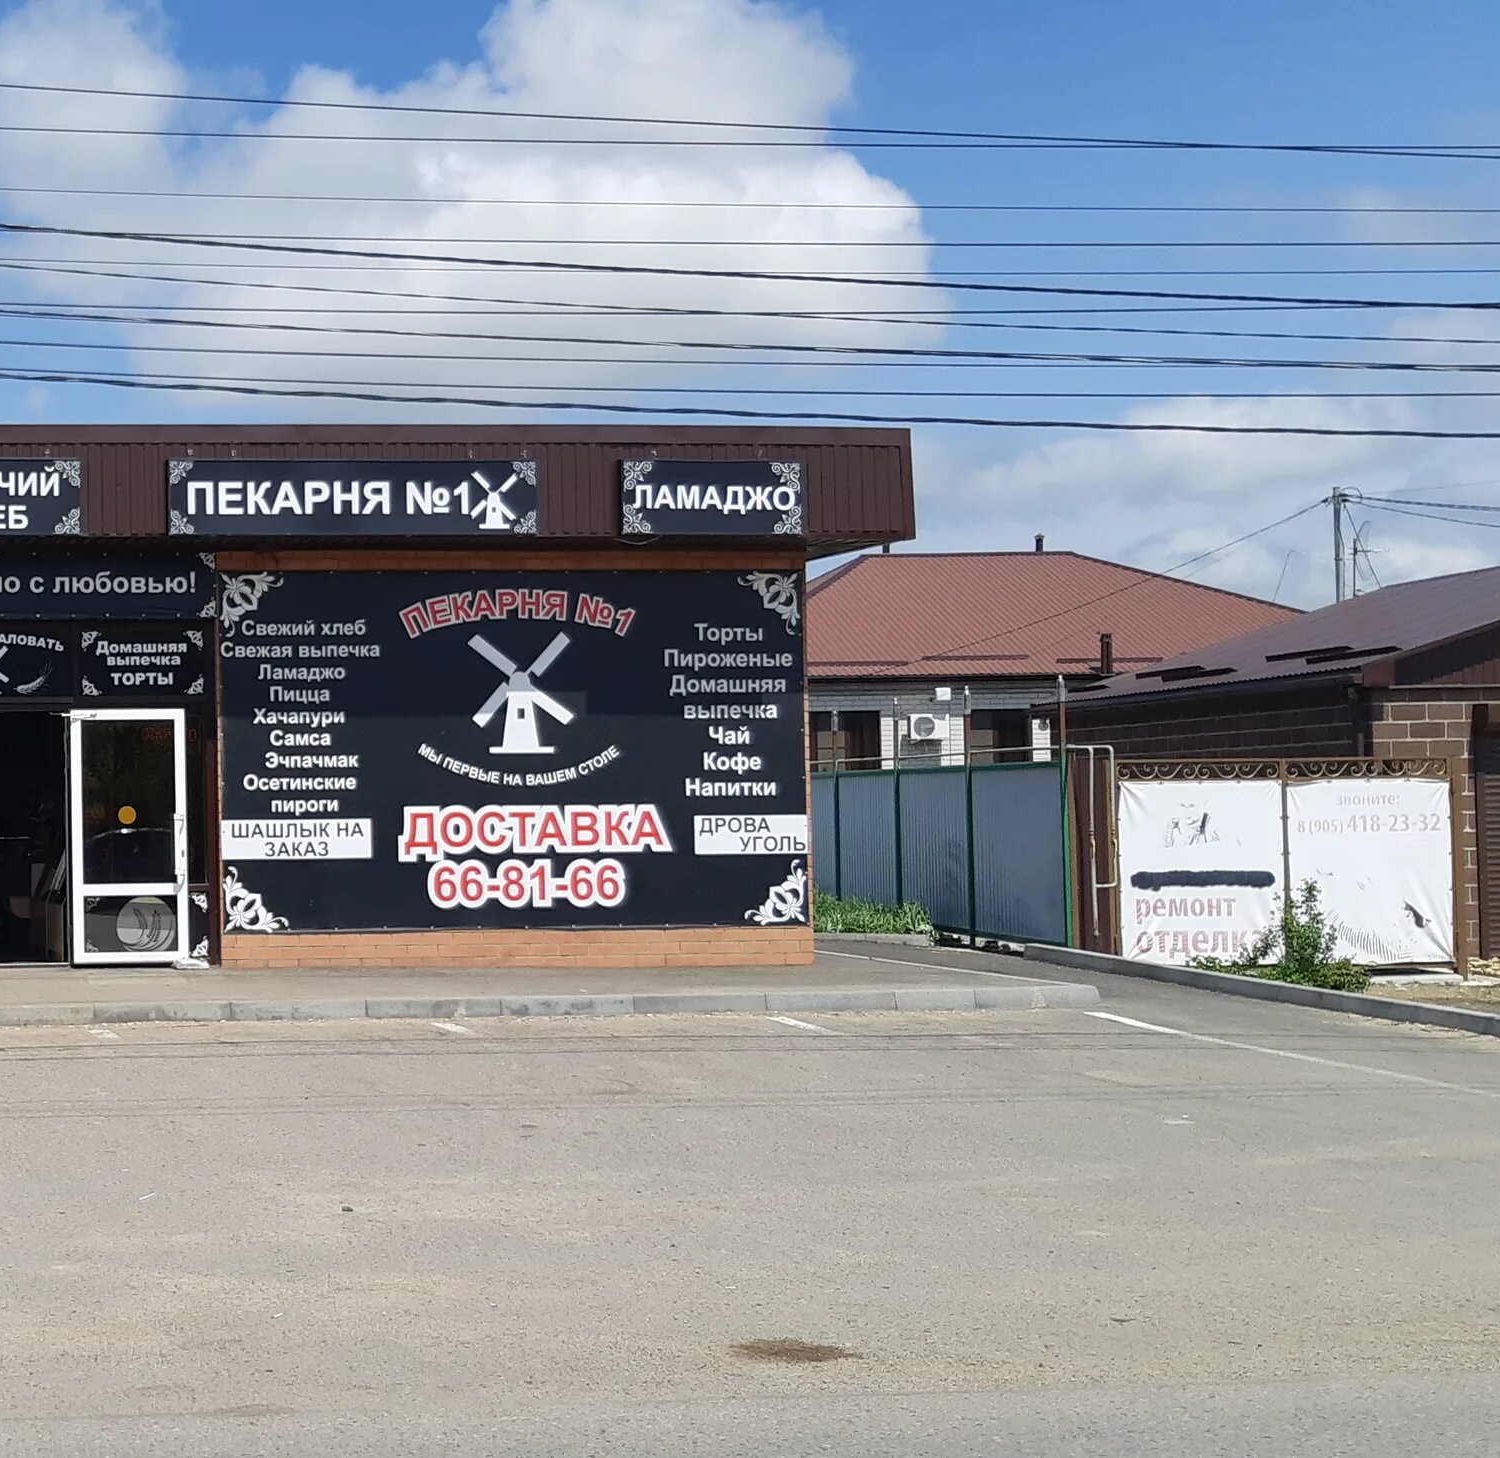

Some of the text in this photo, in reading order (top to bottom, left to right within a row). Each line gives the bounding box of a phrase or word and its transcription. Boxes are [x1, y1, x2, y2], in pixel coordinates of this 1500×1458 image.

[185, 480, 470, 516] ПЕКАРНЯ №1
[631, 483, 797, 516] ЛАМАДЖО
[29, 574, 46, 594] с
[52, 570, 198, 595] любовью!
[399, 588, 637, 639] ПЕКАРНЯ №1
[241, 618, 367, 637] Свежий хлеб
[693, 622, 764, 645] Торты
[95, 640, 188, 657] Домашняя
[220, 641, 381, 660] Свежая выпечка
[105, 653, 182, 668] выпечка
[663, 648, 794, 670] Пироженые
[110, 671, 174, 686] ТОРТЫ
[257, 664, 346, 682] Ламаджо
[269, 686, 330, 704] Пицца
[668, 674, 788, 697] Домашняя
[252, 708, 345, 727] Хачапури
[682, 704, 778, 722] выпечка
[269, 730, 332, 746] Самса
[707, 725, 752, 746] Чай
[264, 751, 359, 769] Эчпачмак
[417, 743, 621, 786] МЫ ПЕРВЫЕ НА ВАШЕМ СТОЛЕ
[702, 752, 763, 775] Кофе
[242, 774, 357, 791] Осетинские
[684, 778, 778, 797] Напитки
[270, 797, 339, 816] пироги
[1336, 793, 1400, 807] звоните:
[230, 822, 365, 839] ШАШЛЫК НА
[401, 807, 668, 858] ДОСТАВКА
[698, 816, 772, 836] ДРОВА
[1297, 813, 1442, 836] 8 (905) 418-23-32
[263, 841, 330, 858] ЗАКАЗ
[739, 835, 807, 852] УГОЛЬ
[430, 862, 623, 905] 66-81-66
[1135, 897, 1237, 925] ремонт
